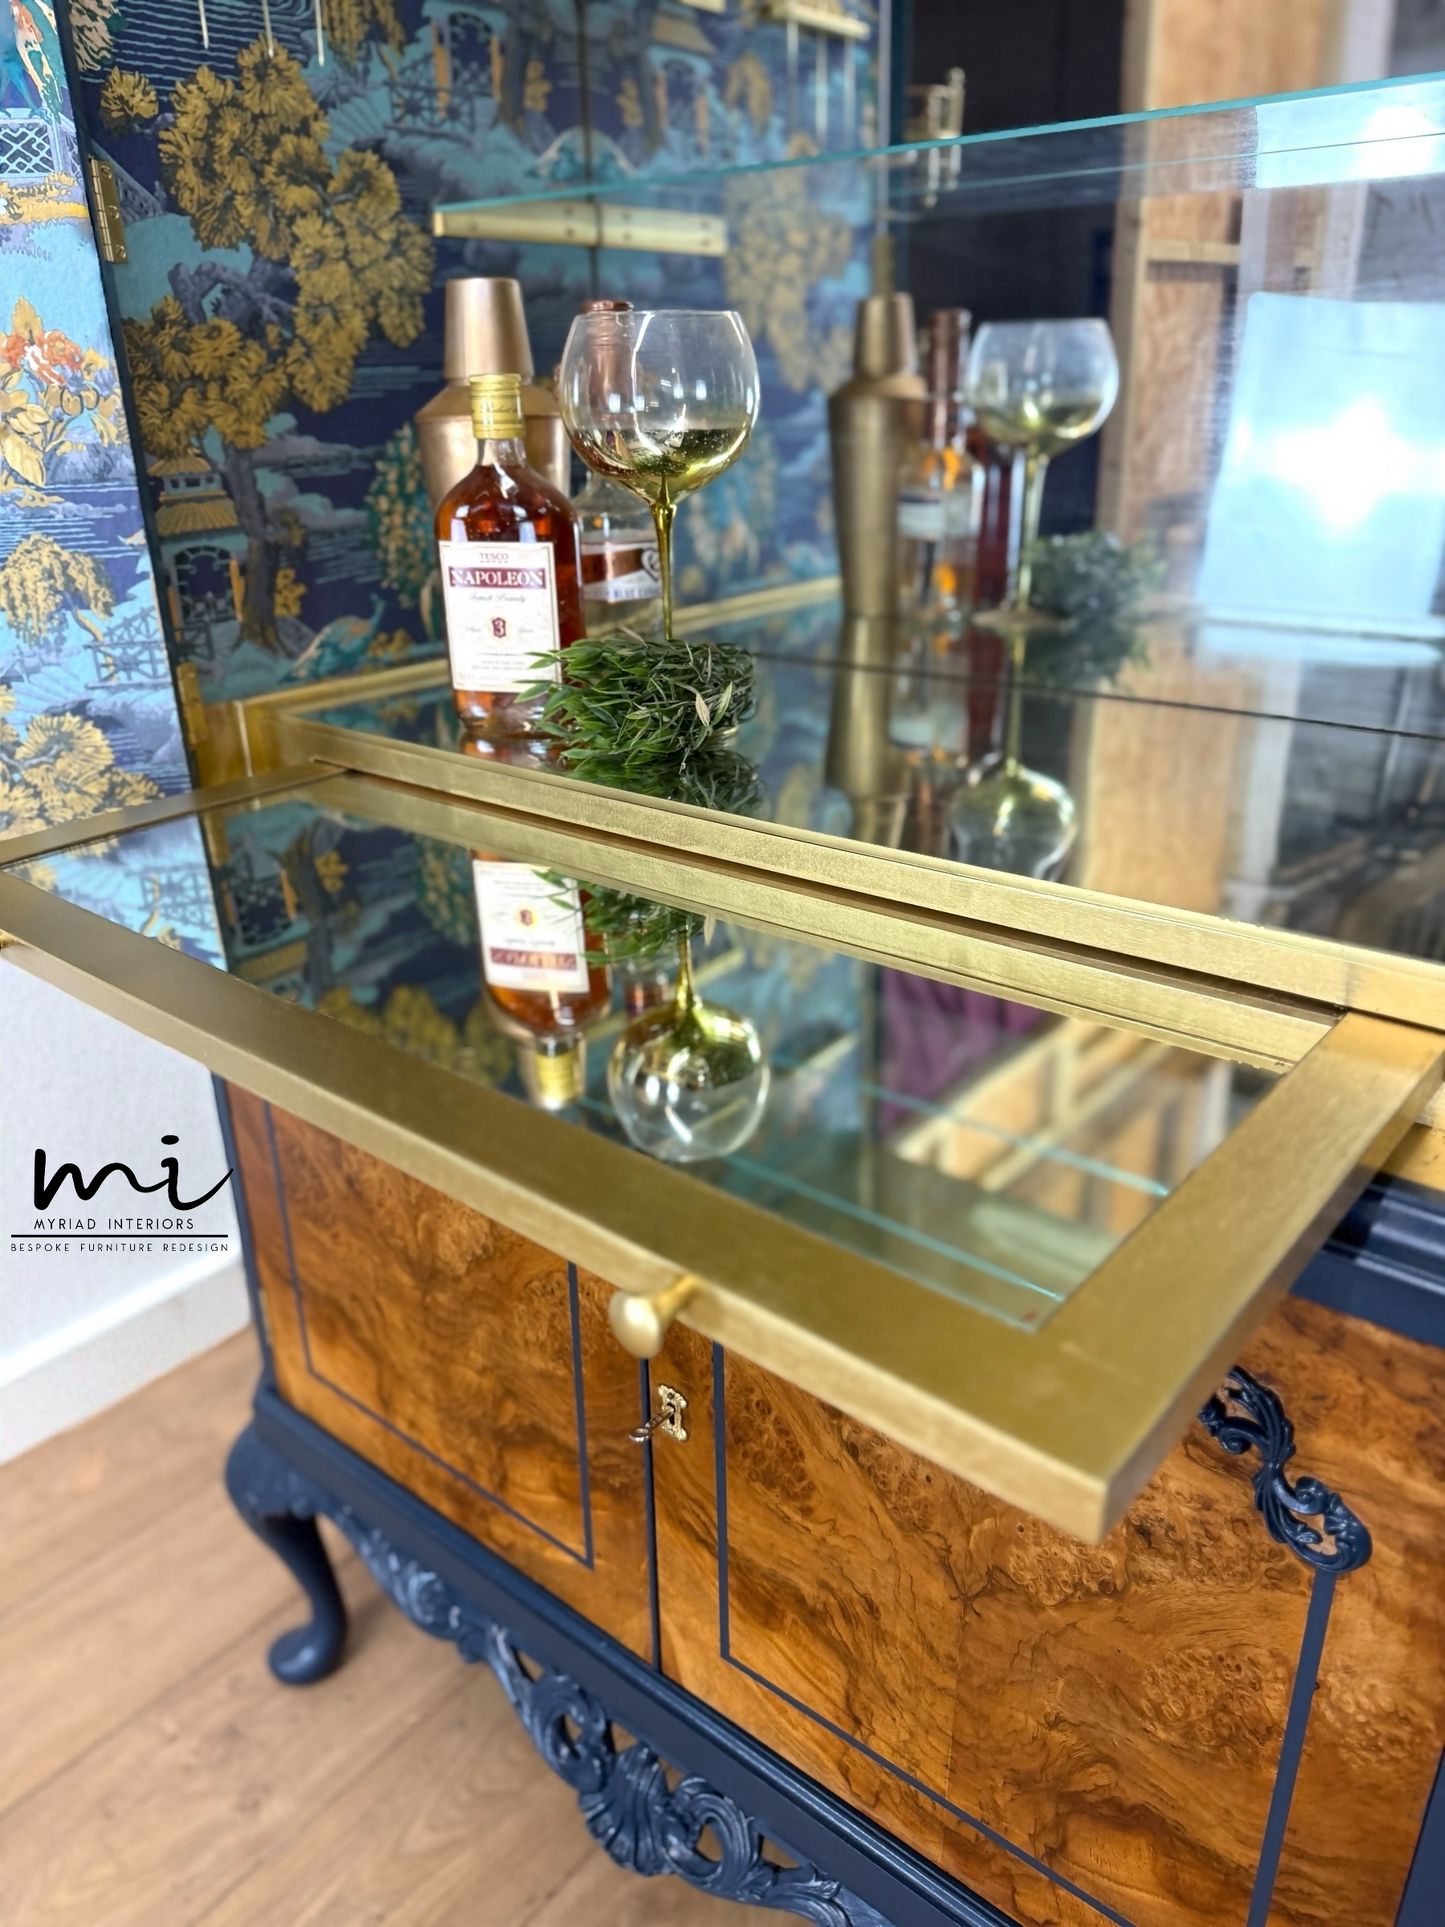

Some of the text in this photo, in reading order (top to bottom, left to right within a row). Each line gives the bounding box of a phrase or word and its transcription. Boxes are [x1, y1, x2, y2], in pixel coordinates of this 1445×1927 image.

[479, 552, 509, 561] TESCO
[450, 569, 544, 588] NAPOLEON
[494, 619, 505, 636] 3
